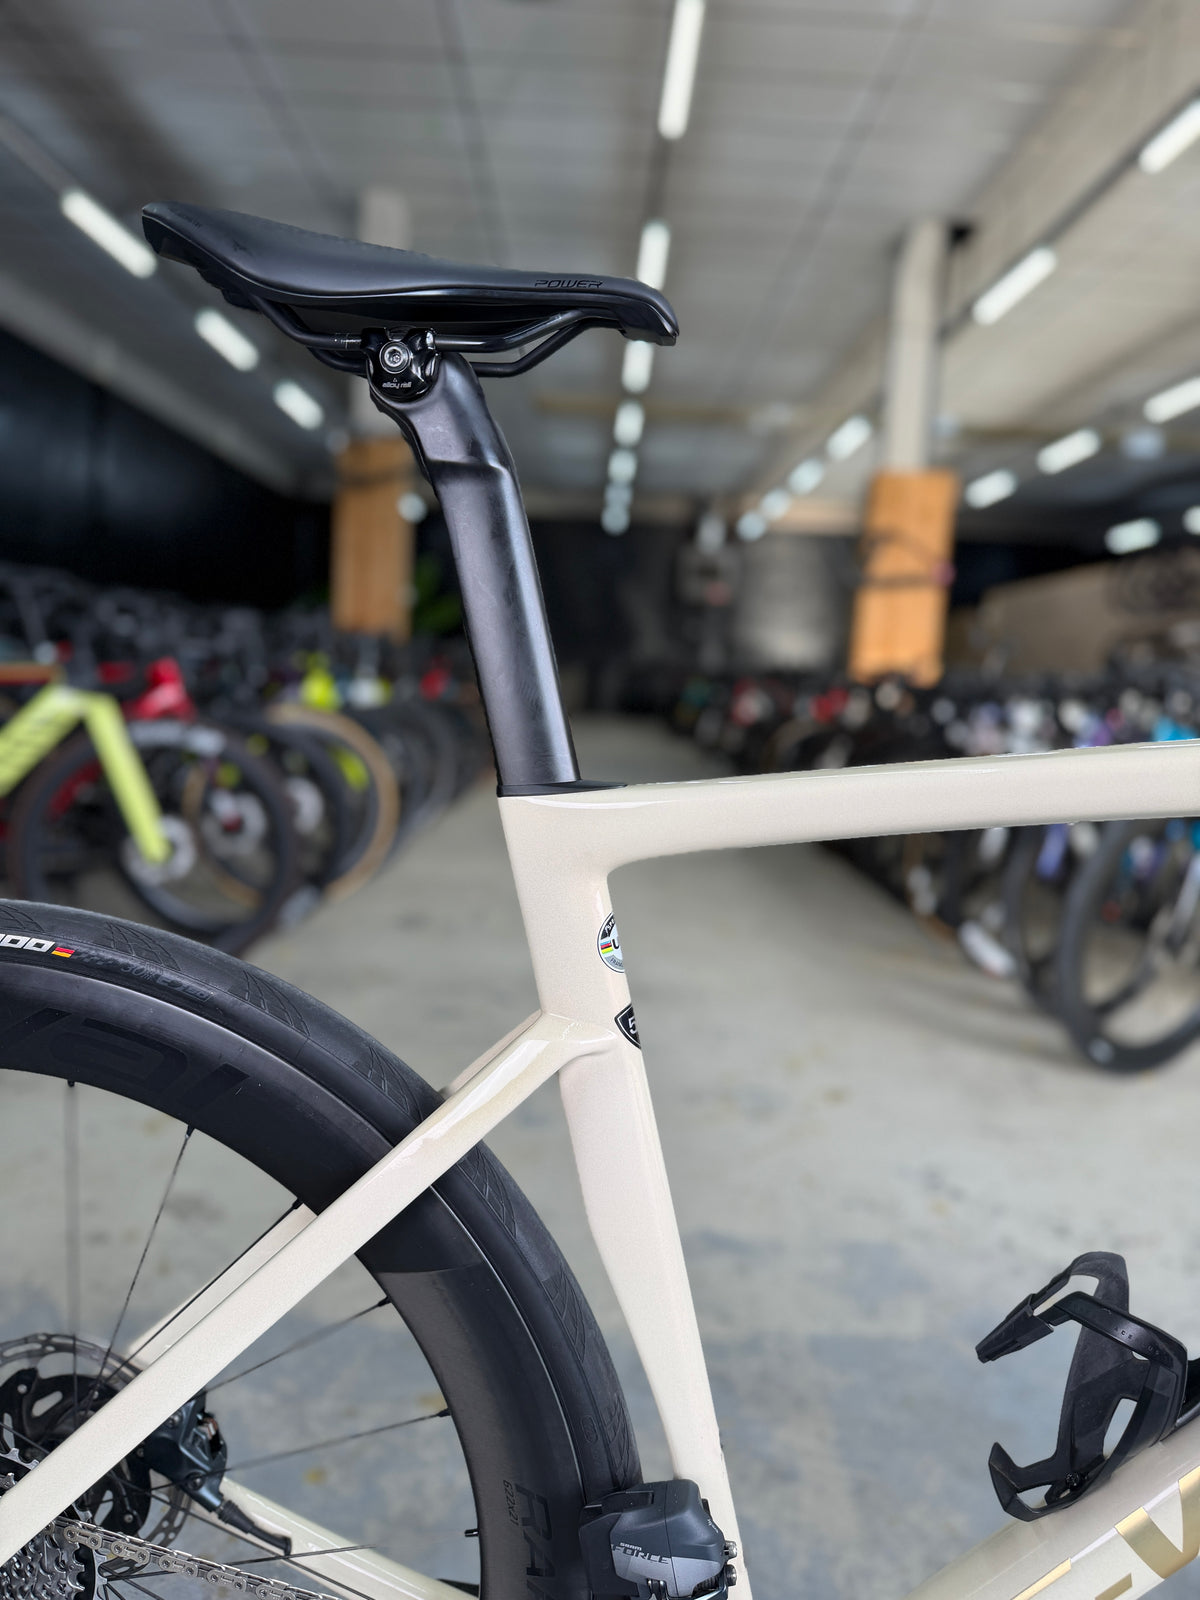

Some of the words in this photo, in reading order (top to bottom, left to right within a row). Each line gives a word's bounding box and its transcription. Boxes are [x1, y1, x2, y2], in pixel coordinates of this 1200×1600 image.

[534, 279, 603, 289] POWER
[0, 933, 56, 953] 00
[503, 1480, 519, 1526] 622x21
[612, 1544, 669, 1565] FORCE
